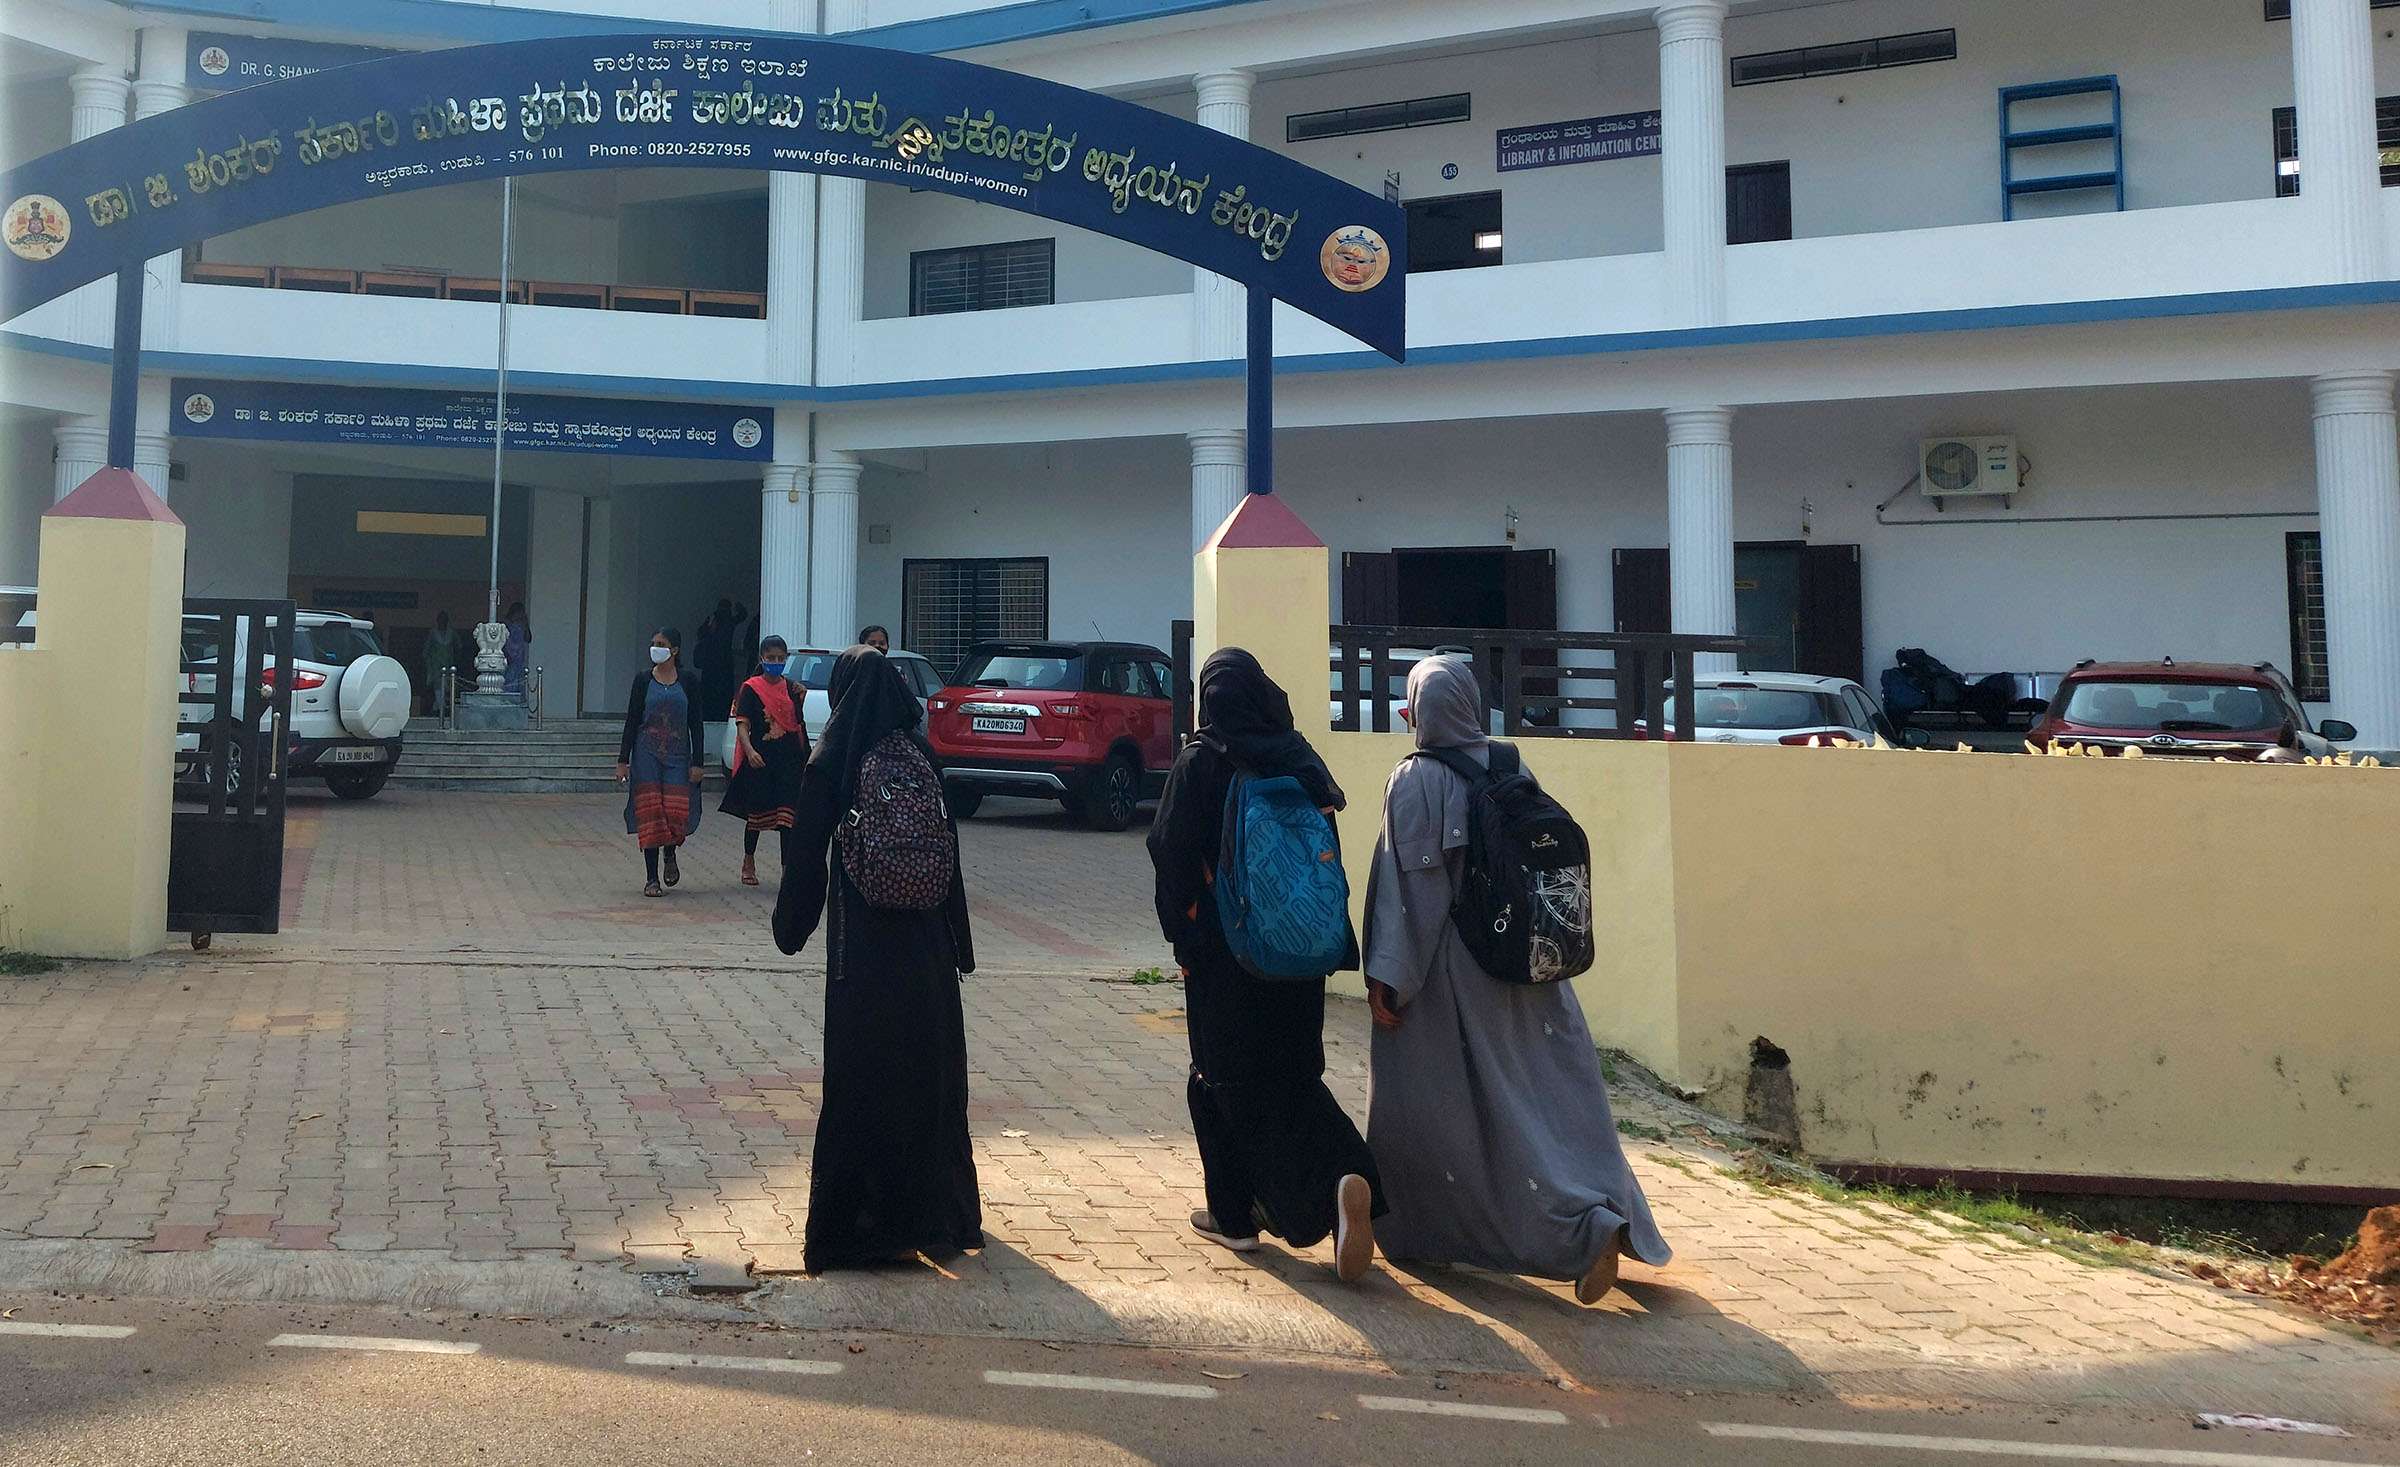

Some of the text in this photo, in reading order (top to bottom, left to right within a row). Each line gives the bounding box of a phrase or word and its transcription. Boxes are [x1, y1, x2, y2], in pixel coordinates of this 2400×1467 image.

[241, 61, 260, 76] DR.
[264, 64, 276, 77] G.
[593, 53, 808, 80] ಕಾಲೇಜು ಶಿಕ್ಷಣ ಇಲಾಖೆ
[1564, 124, 1592, 139] ಮತ್ತು
[1501, 135, 1662, 167] LIBRARY & INFORMATION CENT
[184, 130, 282, 194] ಶಂಕರ್
[294, 109, 400, 166] ಸರ್ಕಾರಿ
[412, 94, 508, 141] ಮಹಿಳಾ
[519, 79, 602, 143] ಪ್ರಥಮ
[615, 77, 678, 124] ದರ್ಜೆ
[692, 80, 805, 128] ಕಾಲೇಜು
[1082, 146, 1210, 215] ಅಧ್ಯಯನ
[1211, 184, 1299, 262] ಕೇಂದ್ರ
[440, 153, 486, 172] ಉಡುಪಿ
[508, 149, 534, 162] 576
[541, 147, 564, 160] 101
[589, 143, 643, 157] Phone:
[647, 143, 752, 157] 0820-2527955
[773, 146, 1028, 198] www.gfgc.kar.nic.in/udupi-women
[278, 409, 319, 423] ಶಂಕರ್
[324, 412, 365, 426] ಸರ್ಕಾರಿ
[371, 414, 410, 428] ಮಹಿಳಾ
[415, 414, 447, 431] ಪ್ರಥಮ
[453, 416, 478, 430] ದರ್ಜೆ
[533, 420, 559, 438] ಮತ್ತು
[686, 427, 717, 445] ಕೇಂದ್ರ
